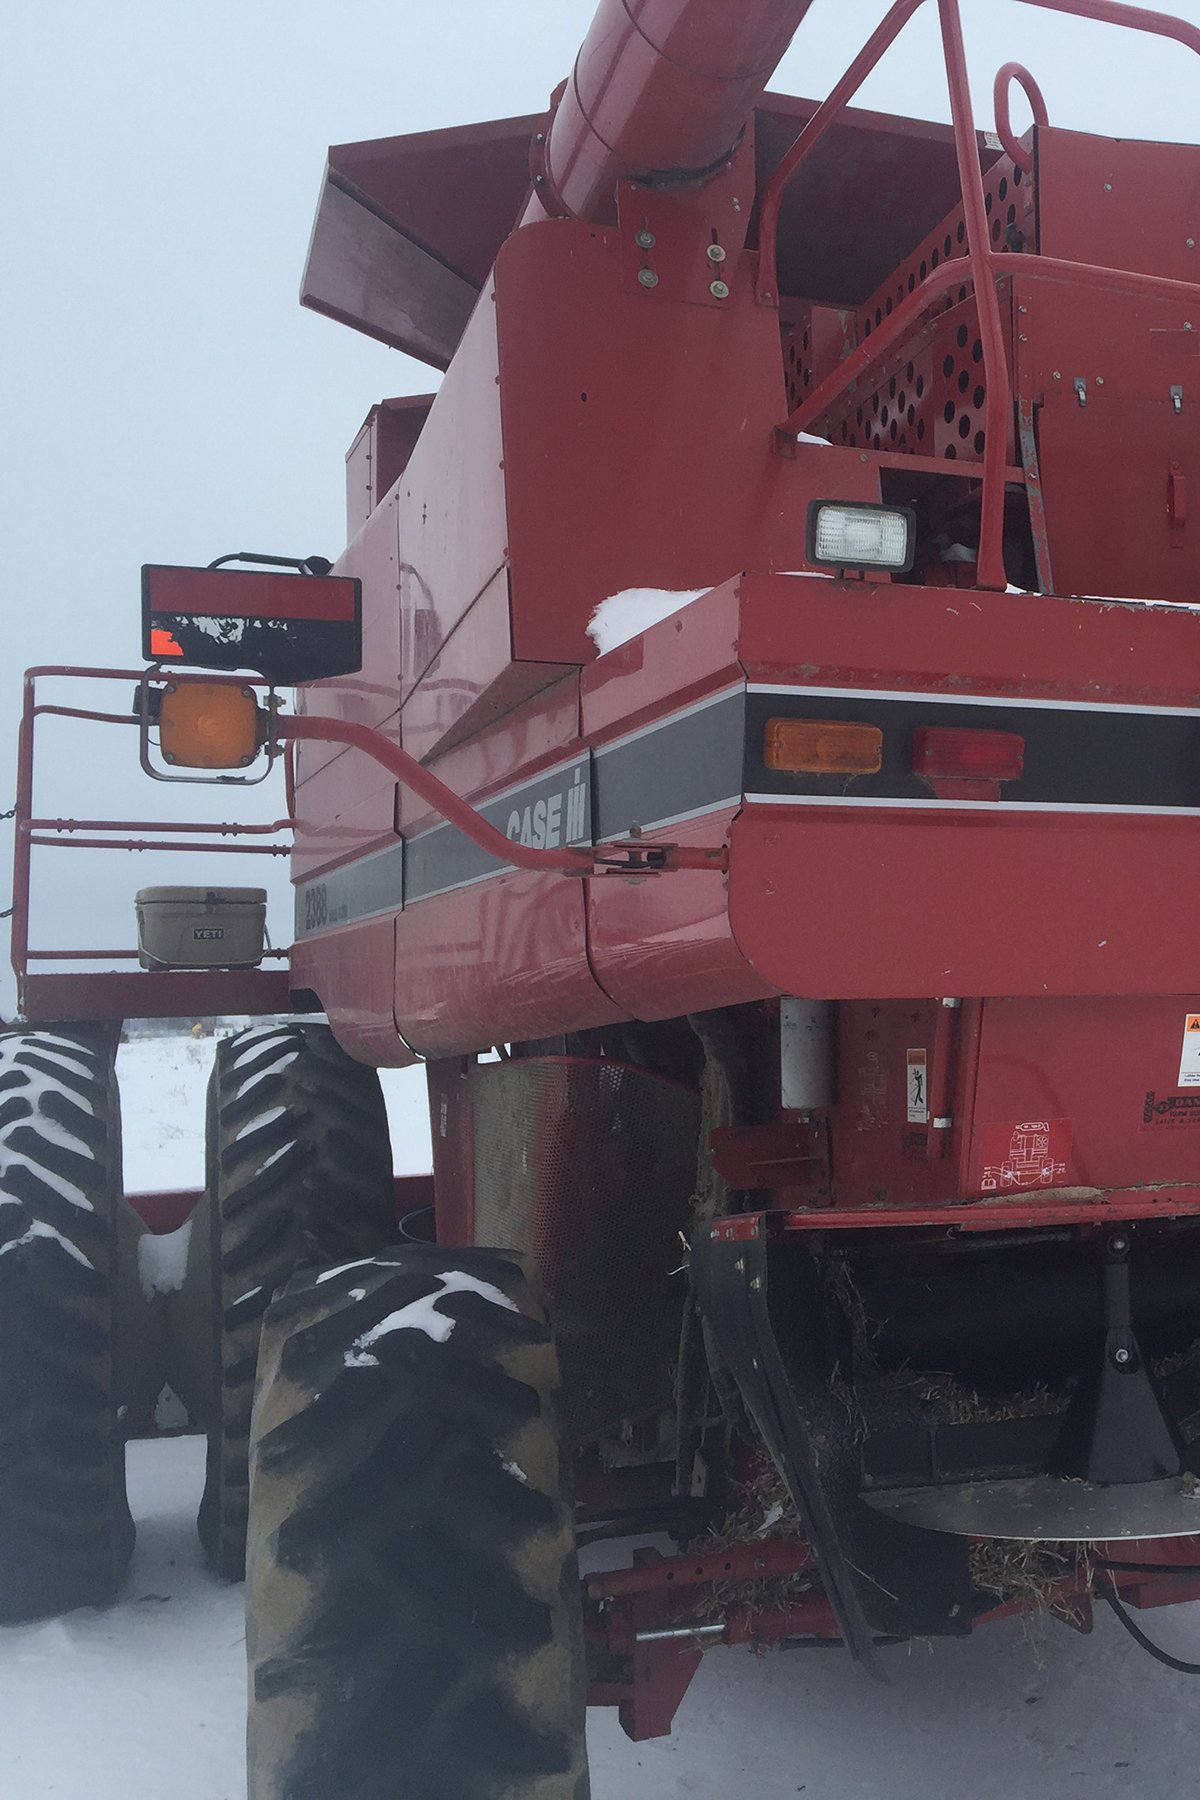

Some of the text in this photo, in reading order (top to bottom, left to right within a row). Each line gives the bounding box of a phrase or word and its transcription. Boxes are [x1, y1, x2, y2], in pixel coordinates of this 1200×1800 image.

[506, 793, 562, 850] CASE
[305, 883, 328, 930] 2388
[195, 930, 223, 938] YETI
